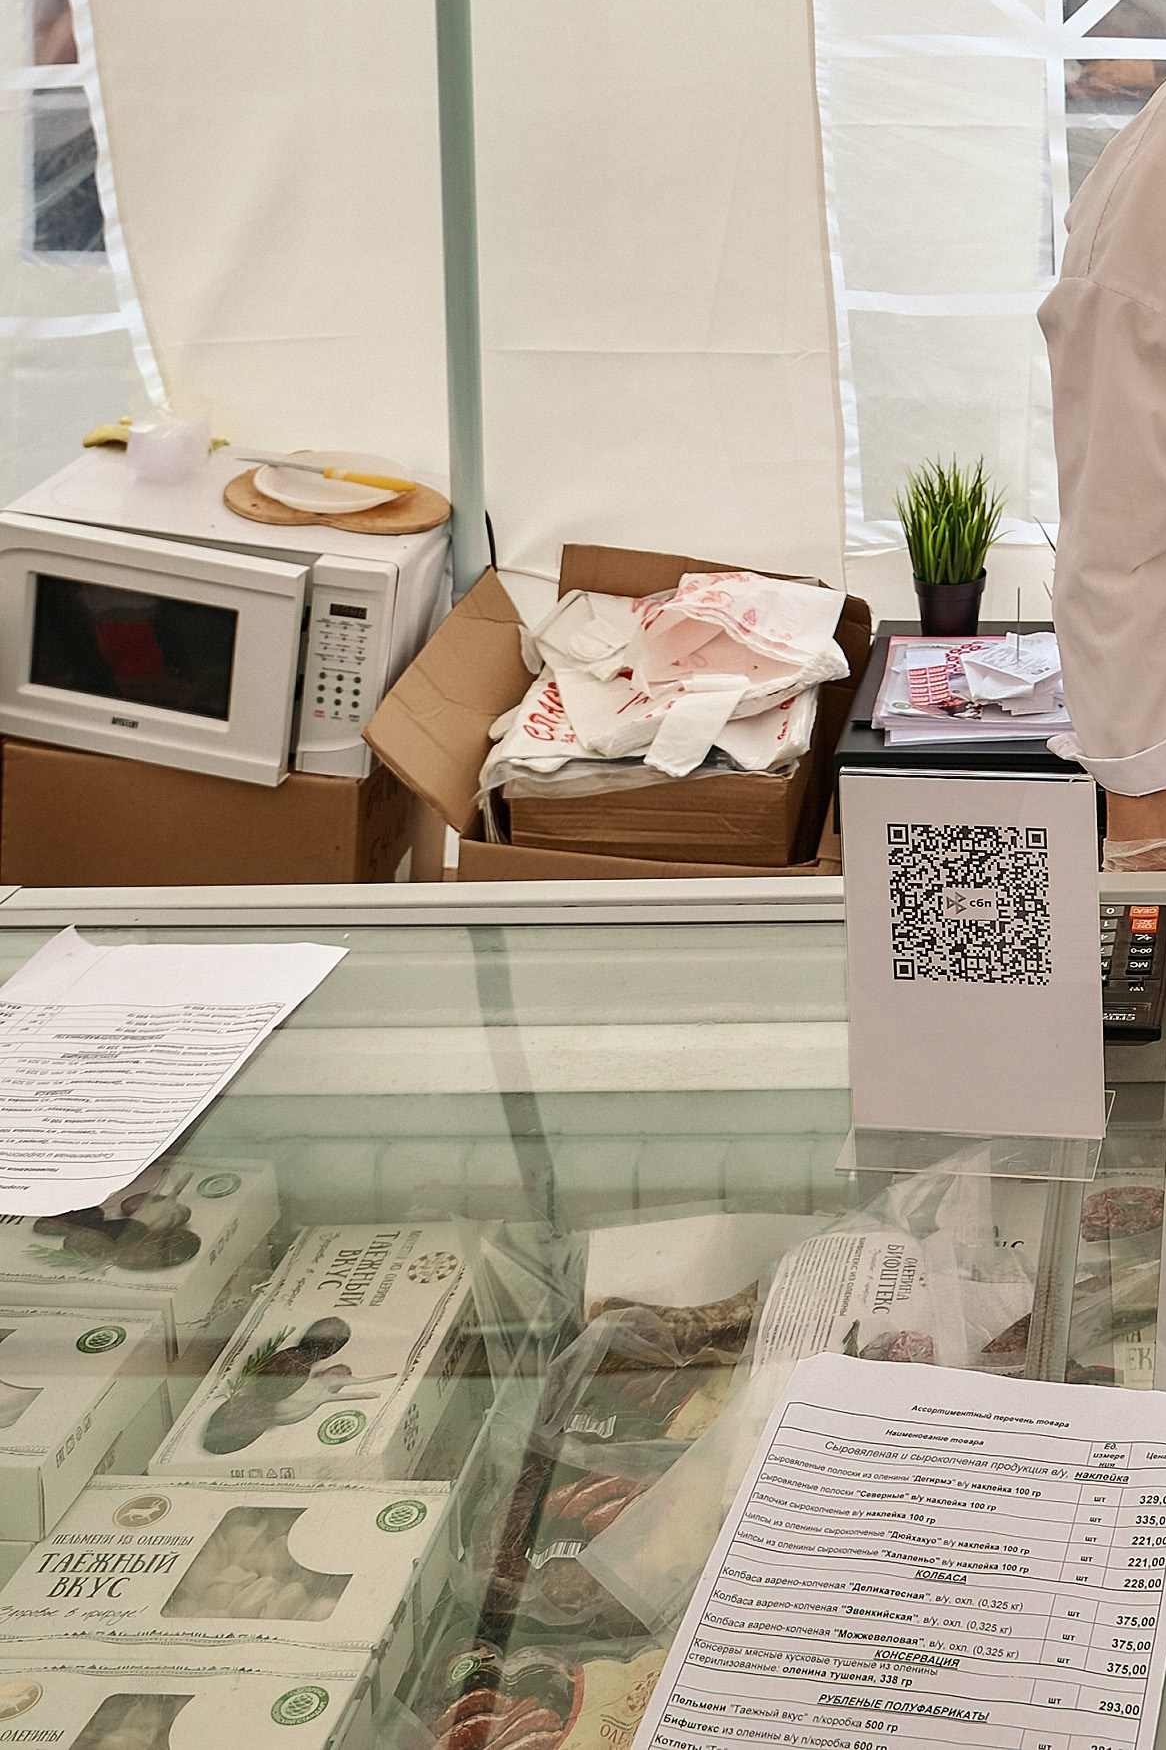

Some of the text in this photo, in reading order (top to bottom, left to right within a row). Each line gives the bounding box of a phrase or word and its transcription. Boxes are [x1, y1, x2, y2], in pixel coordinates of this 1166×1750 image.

[317, 1249, 363, 1290] ВКУС
[872, 1244, 905, 1315] БИФШТЕКС
[897, 1257, 918, 1301] ОЛЕНИНА
[911, 1405, 1070, 1428] Ассортиментный перечень товара
[885, 1429, 985, 1446] Наименование товара
[825, 1441, 899, 1460] Сыровяленая
[910, 1453, 989, 1468] сырокопченая
[991, 1461, 1049, 1476] продукция
[1074, 1471, 1130, 1484] наклейка
[768, 1453, 826, 1471] Сыровяленые
[827, 1466, 861, 1477] полоски
[874, 1473, 909, 1481] оленины
[971, 1483, 1012, 1493] наклейка
[1015, 1487, 1030, 1496] 100
[1032, 1490, 1042, 1498] гр
[52, 1534, 195, 1546] ПЕЛЬМЕНИ ИЗ ОЛЕНИНЫ
[773, 1519, 783, 1527] из
[785, 1521, 823, 1533] оленины
[824, 1527, 885, 1538] сырокопченые
[888, 1530, 942, 1546] "Дюйхакуо"
[958, 1541, 1000, 1551] наклейка
[1002, 1545, 1018, 1554] 100
[1020, 1547, 1030, 1555] гр
[36, 1550, 181, 1574] ТАЁЖНЫЙ
[1127, 1557, 1165, 1568] 221,00
[47, 1576, 130, 1598] ВКУС
[915, 1569, 968, 1583] КОЛБАСА
[1124, 1578, 1162, 1590] 228,00
[722, 1566, 763, 1584] Колбаса
[764, 1576, 846, 1590] варено-копченая
[955, 1597, 975, 1605] охл.
[978, 1599, 1009, 1610] (0,325
[1010, 1602, 1024, 1612] кг)
[1116, 1615, 1155, 1627] 375,00
[704, 1611, 745, 1629] Колбаса
[747, 1621, 831, 1637] варено-копченая
[949, 1643, 970, 1652] охл.
[973, 1645, 1005, 1658] (0,325
[1006, 1649, 1020, 1660] кг)
[1111, 1639, 1151, 1651] 375,00
[693, 1638, 939, 1677] Консервы мясные кусковые тушеные из оленины
[874, 1649, 961, 1669] КОНСЕРВАЦИЯ
[689, 1651, 913, 1688] стерилизованные: оленина тушеная, 338 гр
[1107, 1663, 1147, 1676] 375,00
[671, 1693, 899, 1733] Пельмени "Таежный вкус" п/коробка 500 гр
[818, 1693, 990, 1721] РУБЛЕНЫЕ ПОЛУФАБРИКАТЫ
[1099, 1701, 1140, 1716] 293,00
[0, 1729, 65, 1742] ОЛЕНИНЫ
[655, 1734, 702, 1750] Котлеты
[663, 1713, 720, 1733] Бифштекс
[722, 1726, 734, 1735] из
[736, 1728, 781, 1741] оленины
[783, 1733, 799, 1744] в/у
[801, 1736, 851, 1749] п/коробка
[854, 1740, 873, 1750] 600
